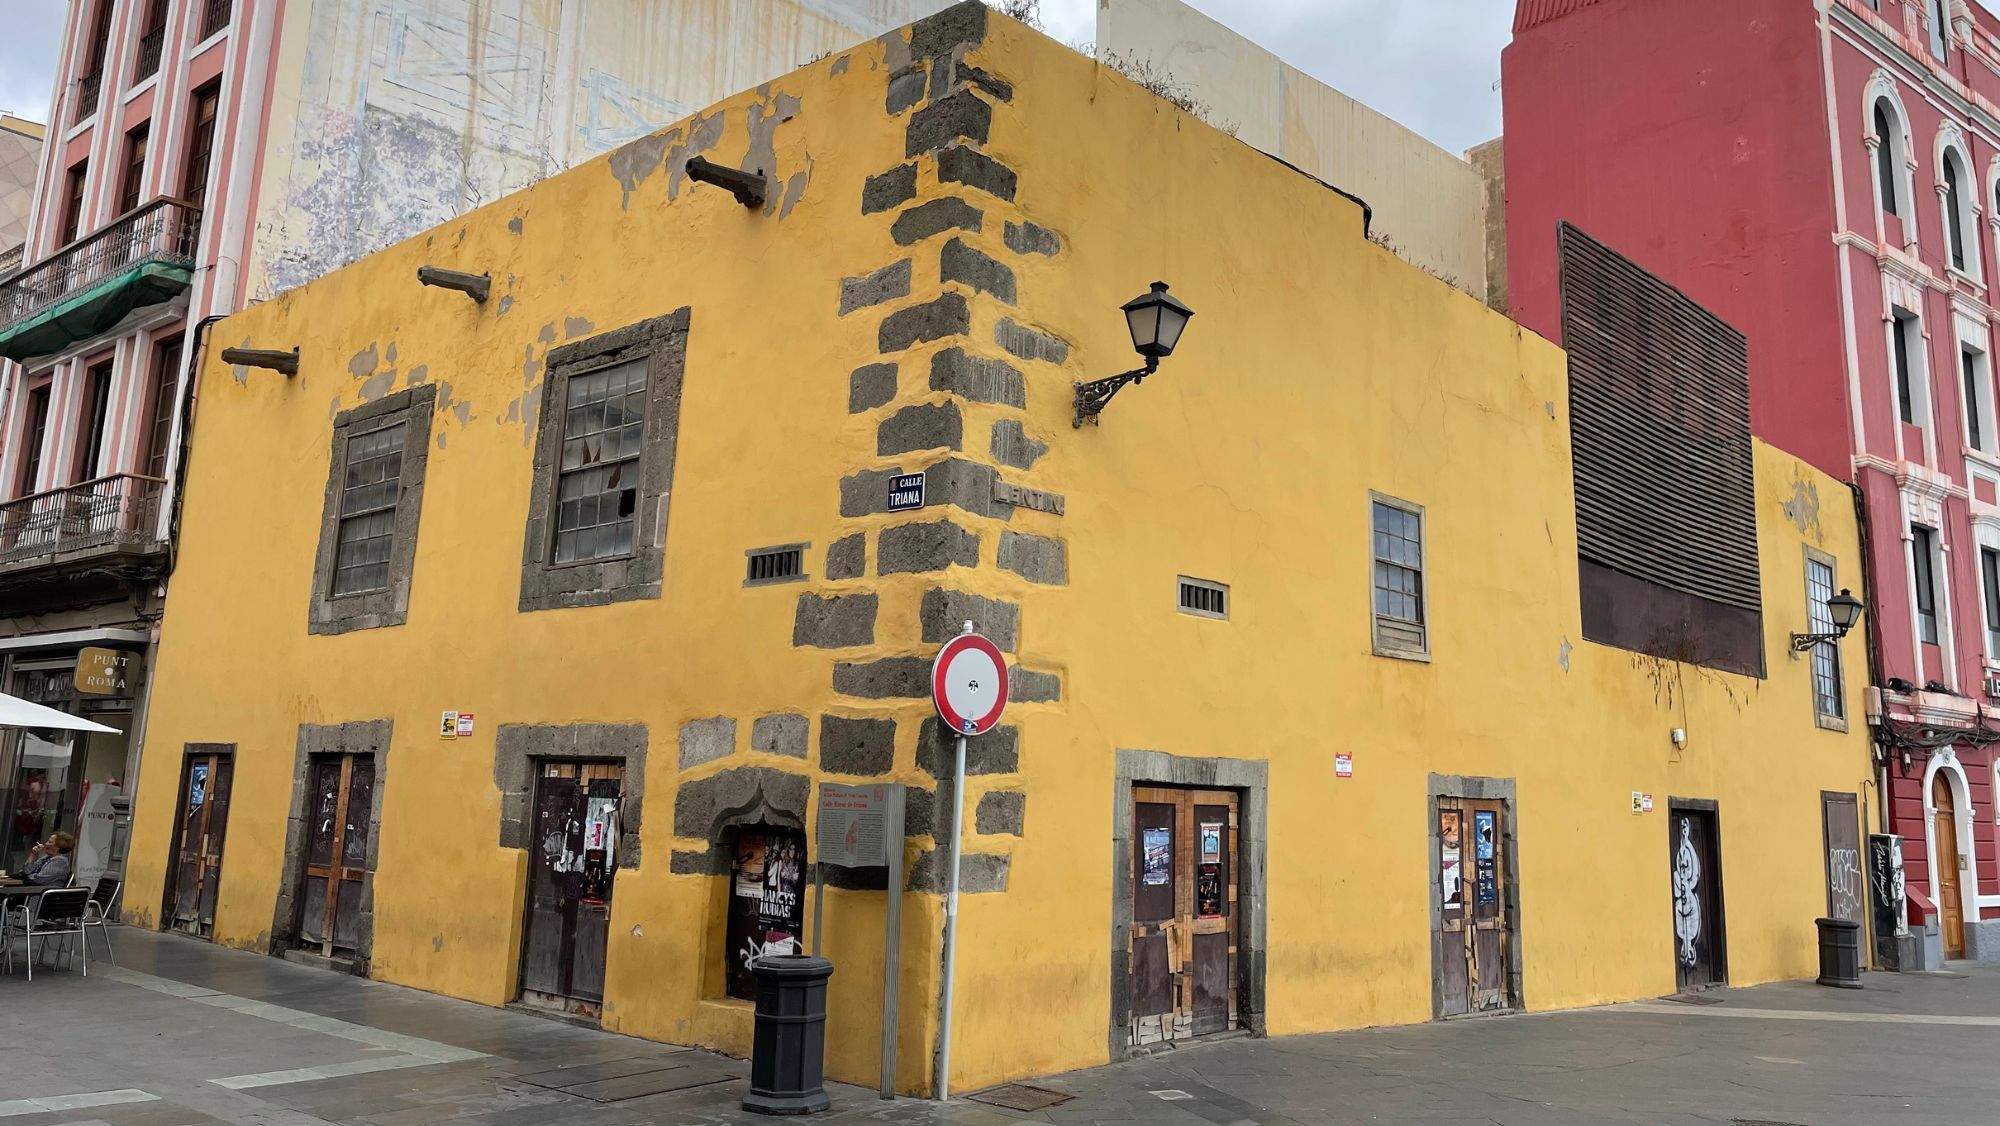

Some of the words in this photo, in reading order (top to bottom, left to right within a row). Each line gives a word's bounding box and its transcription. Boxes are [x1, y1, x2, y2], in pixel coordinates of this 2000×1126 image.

[899, 476, 922, 488] CALLE
[889, 490, 920, 506] TRIANA
[93, 654, 129, 667] PUNT
[87, 675, 126, 689] ROMA
[759, 901, 791, 918] RUBIAS
